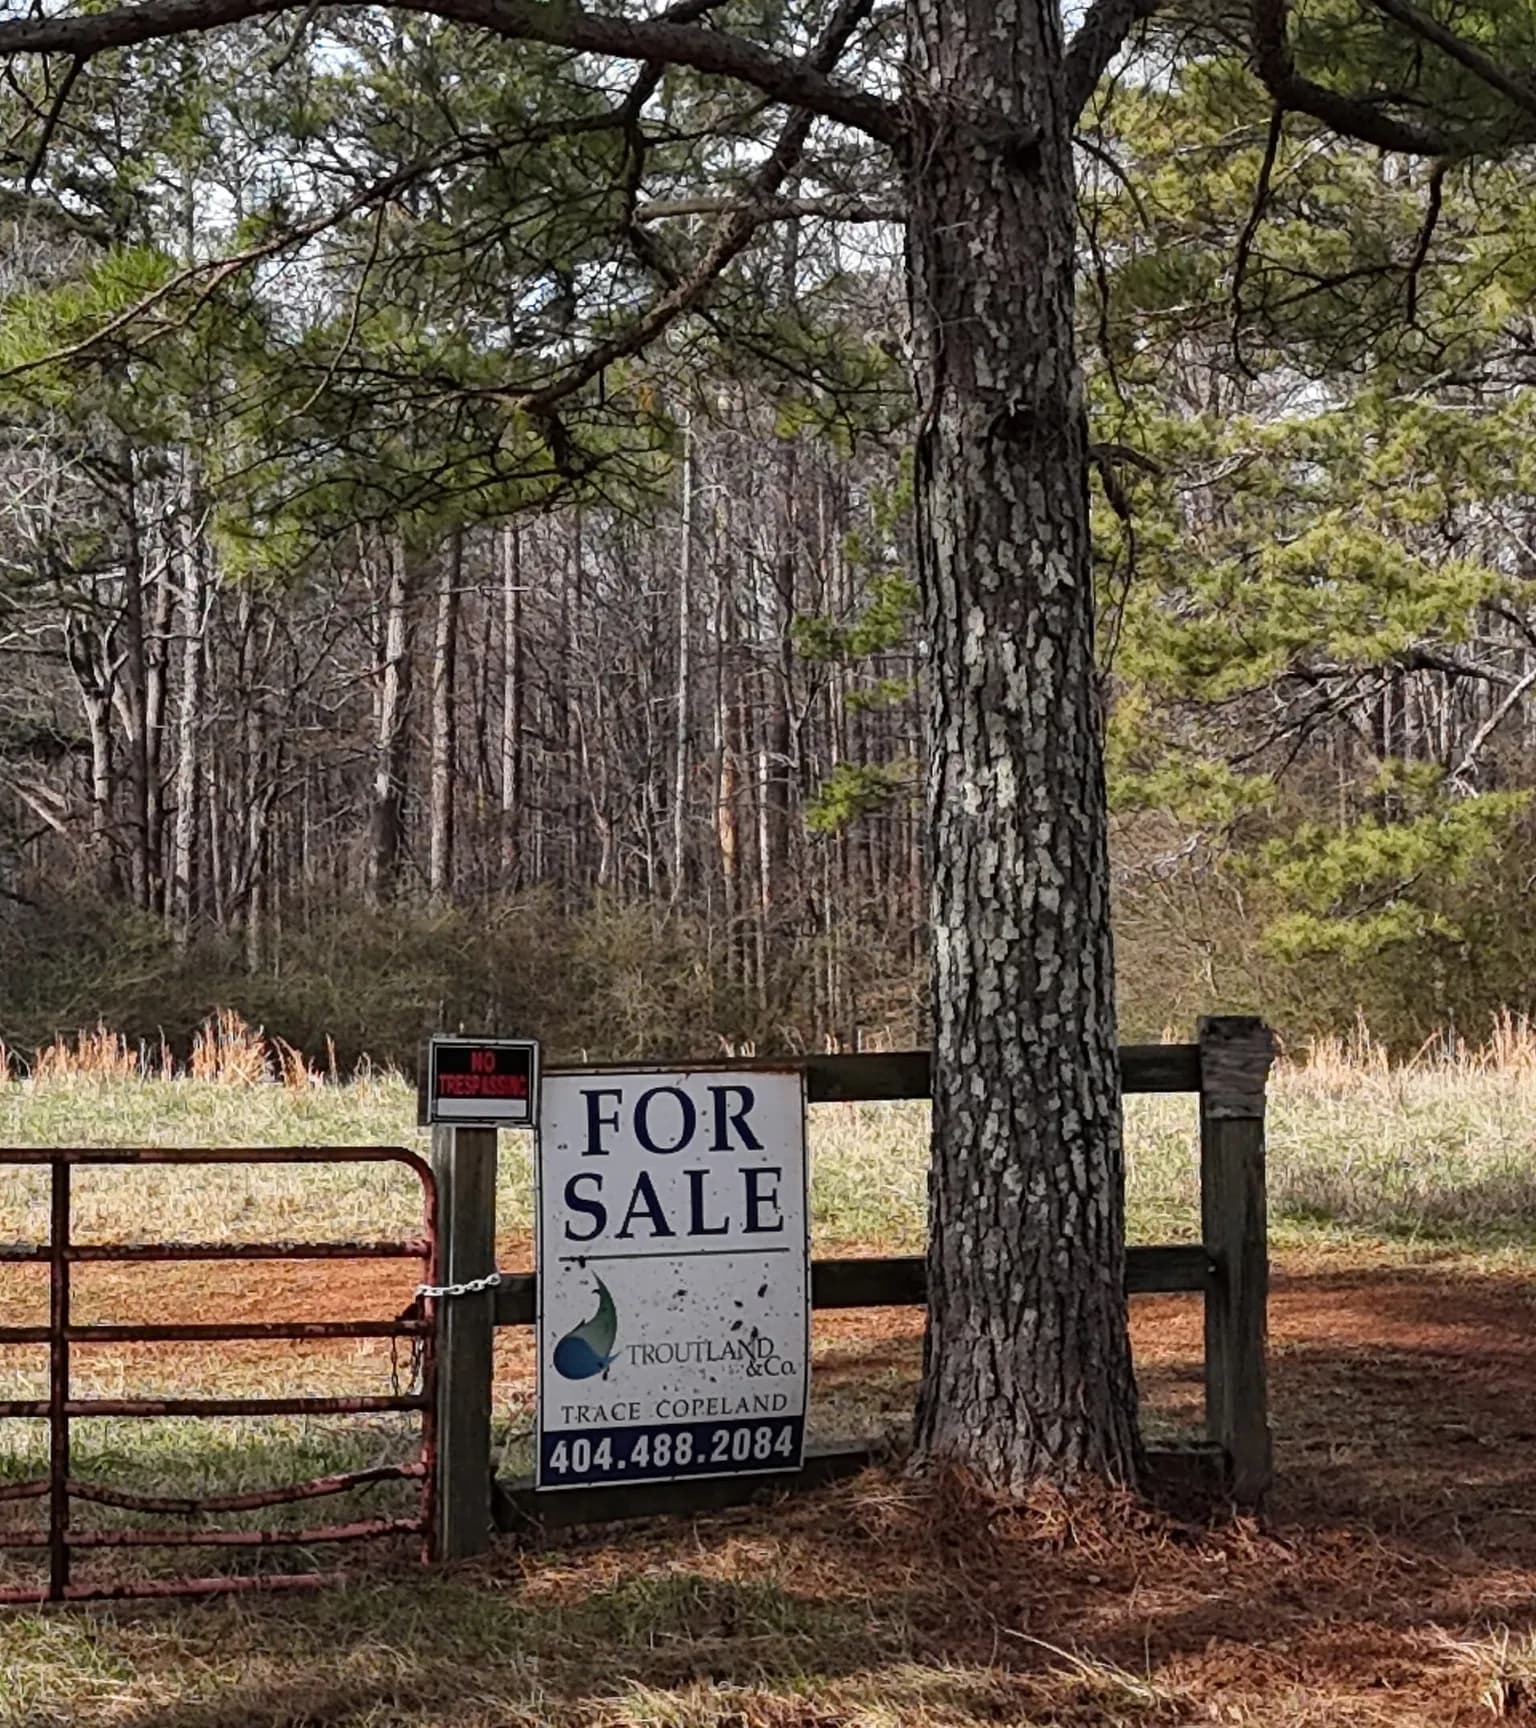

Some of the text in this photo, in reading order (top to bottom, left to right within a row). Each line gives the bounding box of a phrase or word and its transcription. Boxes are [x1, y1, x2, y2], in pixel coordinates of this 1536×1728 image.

[471, 1050, 496, 1072] NO
[438, 1074, 527, 1096] TRESPASSING
[579, 1085, 764, 1156] FOR
[564, 1167, 784, 1241] SALE
[626, 1337, 774, 1365] TROUTLAND
[746, 1355, 797, 1377] &Co.
[561, 1394, 788, 1424] TRACE COPELAND
[549, 1425, 794, 1474] 404.488.2084
